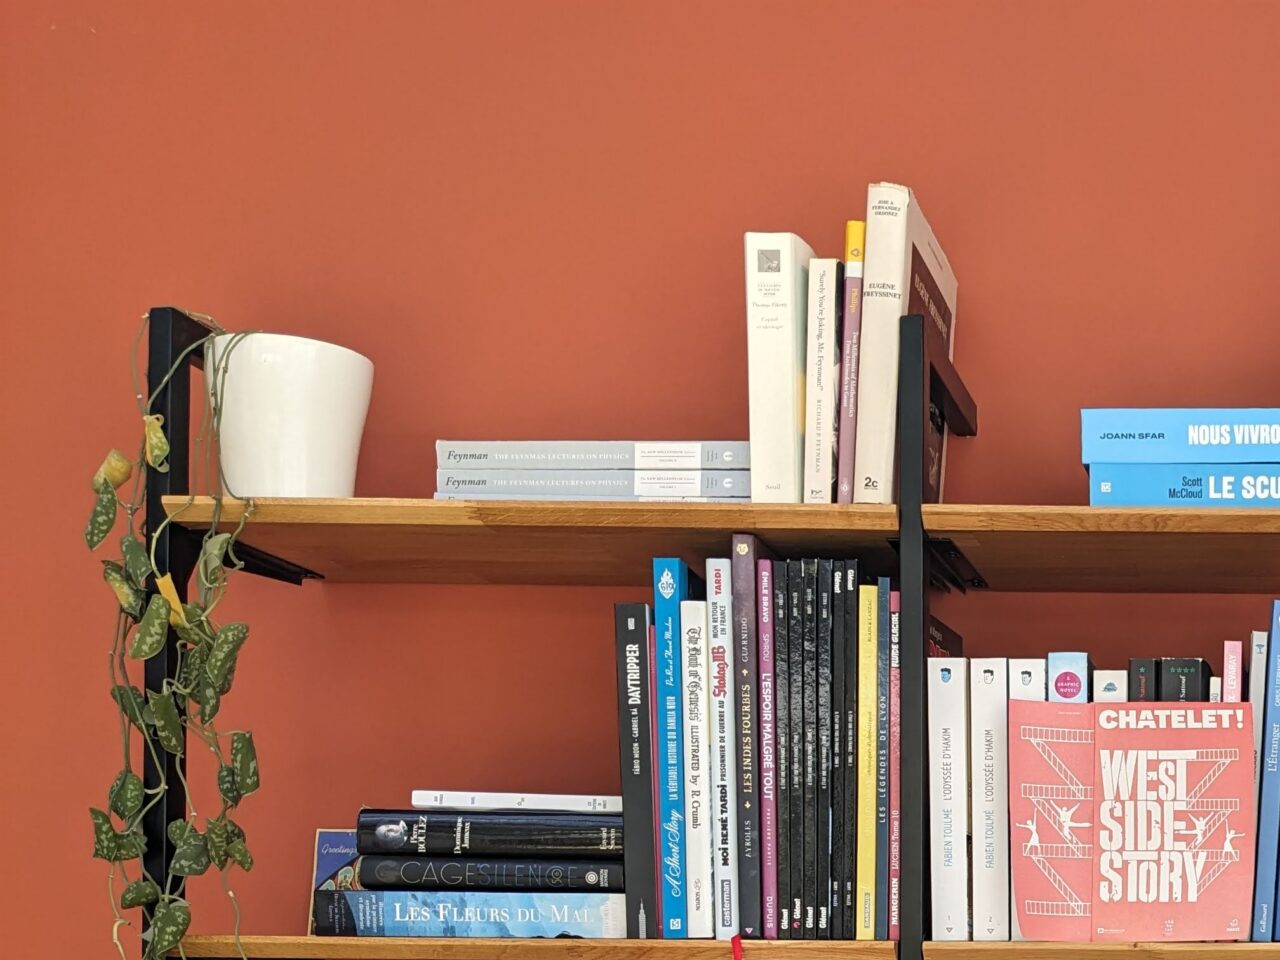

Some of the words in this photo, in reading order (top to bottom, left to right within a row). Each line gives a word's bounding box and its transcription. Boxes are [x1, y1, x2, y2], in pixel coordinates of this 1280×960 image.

[863, 291, 902, 299] FREYSSINET
[1099, 432, 1136, 440] JOANN
[1138, 432, 1166, 440] SFAR
[1188, 424, 1230, 445] NOUS
[447, 450, 488, 463] Feynman
[446, 476, 488, 489] Feynman
[1168, 487, 1203, 499] McCloud
[1182, 476, 1203, 488] Scott
[1208, 476, 1235, 499] LE
[714, 568, 722, 596] TARDI
[760, 571, 770, 595] ÉMILE
[711, 602, 719, 623] RETOUR
[719, 605, 727, 627] FRANCE
[760, 596, 770, 623] BRAVO
[712, 625, 720, 639] MON
[719, 627, 727, 635] EN
[741, 617, 750, 662] GUARNIDO
[890, 612, 900, 643] GLACIAL
[761, 633, 771, 662] SPIROU
[890, 643, 901, 668] FLUIDE
[626, 643, 641, 705] DAYTRIPPER
[741, 684, 752, 734] FOURBES
[761, 672, 773, 721] L'ESPOIR
[1098, 709, 1245, 730] CHATELET!
[742, 736, 752, 771] INDES
[761, 723, 775, 768] MALGRÉ
[941, 727, 952, 759] D'HAKIM
[984, 729, 994, 760] D'HAKIM
[1266, 722, 1280, 772] L'Étranger
[743, 773, 753, 793] LES
[762, 770, 774, 801] TOUT
[941, 761, 952, 801] L'ODYSSÉE
[983, 763, 994, 802] L'ODYSSÉE
[1099, 748, 1197, 800] WEST
[662, 807, 683, 844] Story
[891, 809, 900, 819] 10
[941, 808, 952, 838] TOULMÉ
[983, 809, 994, 839] TOULMÉ
[1099, 800, 1188, 851] SIDE
[418, 815, 428, 853] BOULEZ
[744, 820, 753, 858] AYROLES
[891, 821, 899, 841] Tome
[663, 842, 682, 879] Short
[891, 842, 900, 870] LUCIEN
[943, 841, 952, 867] FABIEN
[984, 842, 994, 869] FABIEN
[400, 860, 477, 887] CAGE
[1099, 850, 1208, 903] STORY
[665, 879, 681, 898] A
[891, 878, 900, 925] MARGERIN
[393, 902, 431, 922] LES
[435, 901, 511, 922] FLEURS
[515, 908, 541, 922] DU
[550, 904, 594, 923] MAL
[722, 881, 731, 926] casterman
[765, 896, 774, 929] DUPUIS
